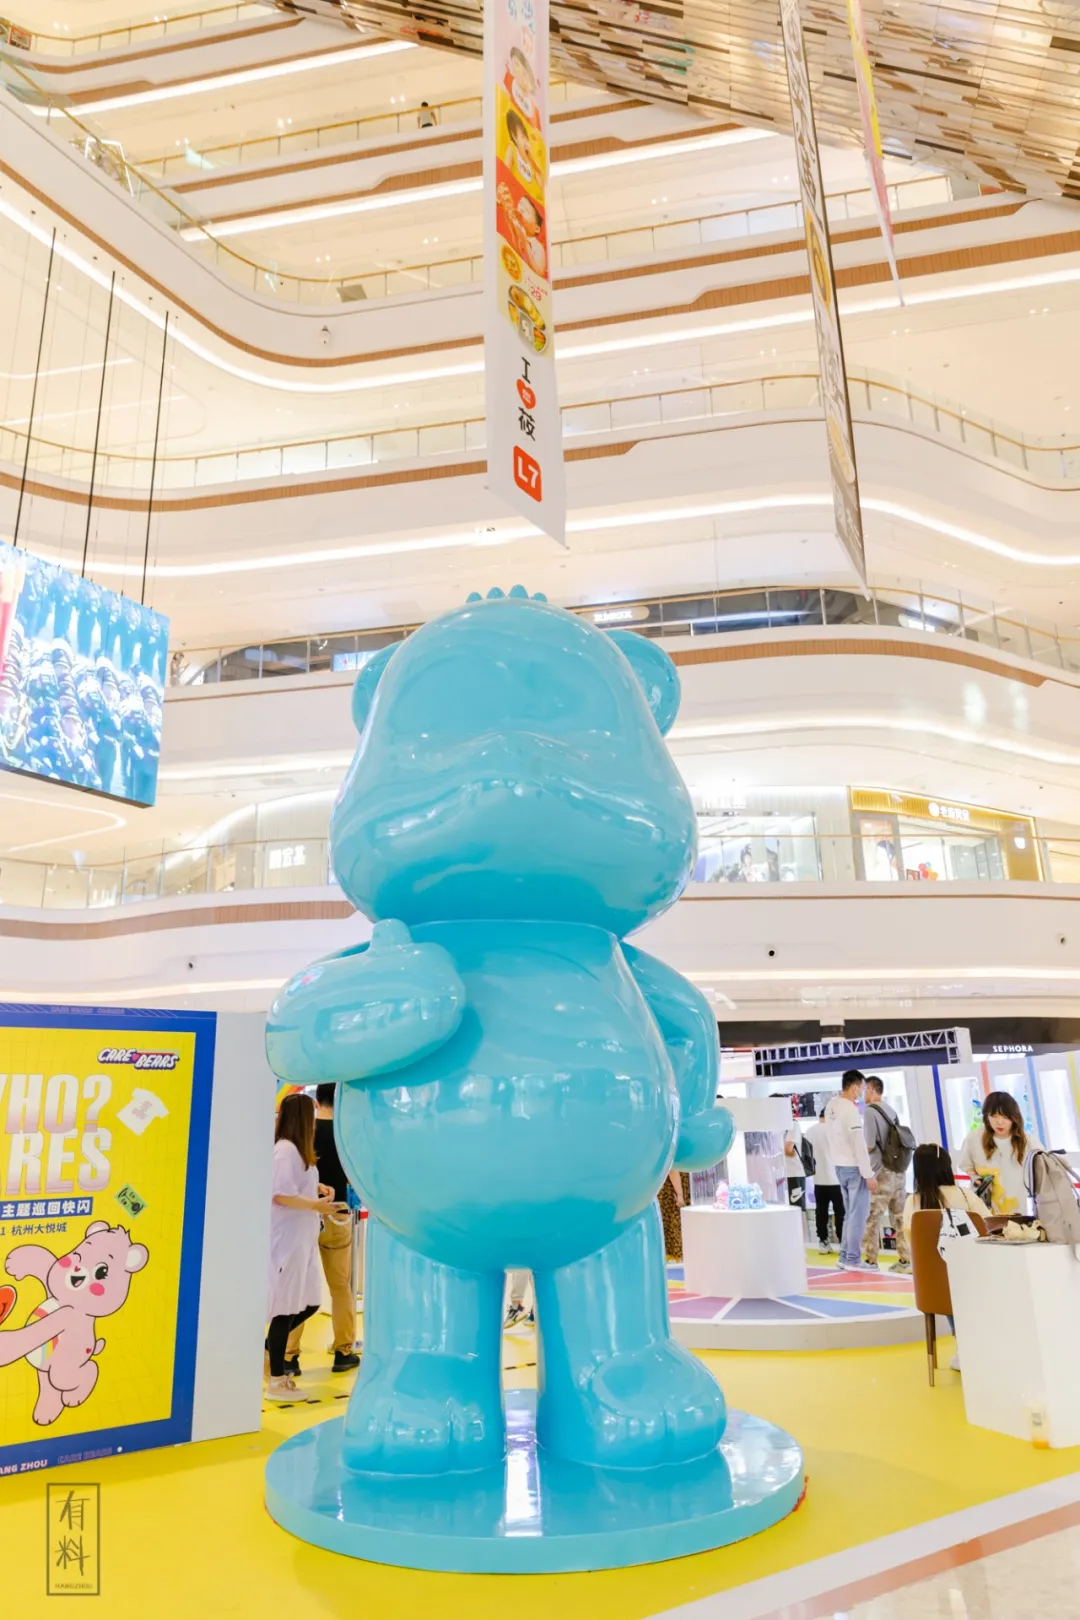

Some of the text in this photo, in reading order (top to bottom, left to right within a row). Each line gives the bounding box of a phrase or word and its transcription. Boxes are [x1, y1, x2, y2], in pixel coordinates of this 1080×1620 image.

[518, 456, 538, 489] L7
[992, 1044, 1034, 1053] SEPHORA
[97, 1048, 179, 1070] CARE BEARS
[0, 1073, 113, 1134] HO?
[0, 1128, 112, 1196] RES
[1, 1199, 91, 1218] 主题巡回快闪
[11, 1222, 68, 1236] 杭州大悦城
[20, 1459, 48, 1471] ZHOU
